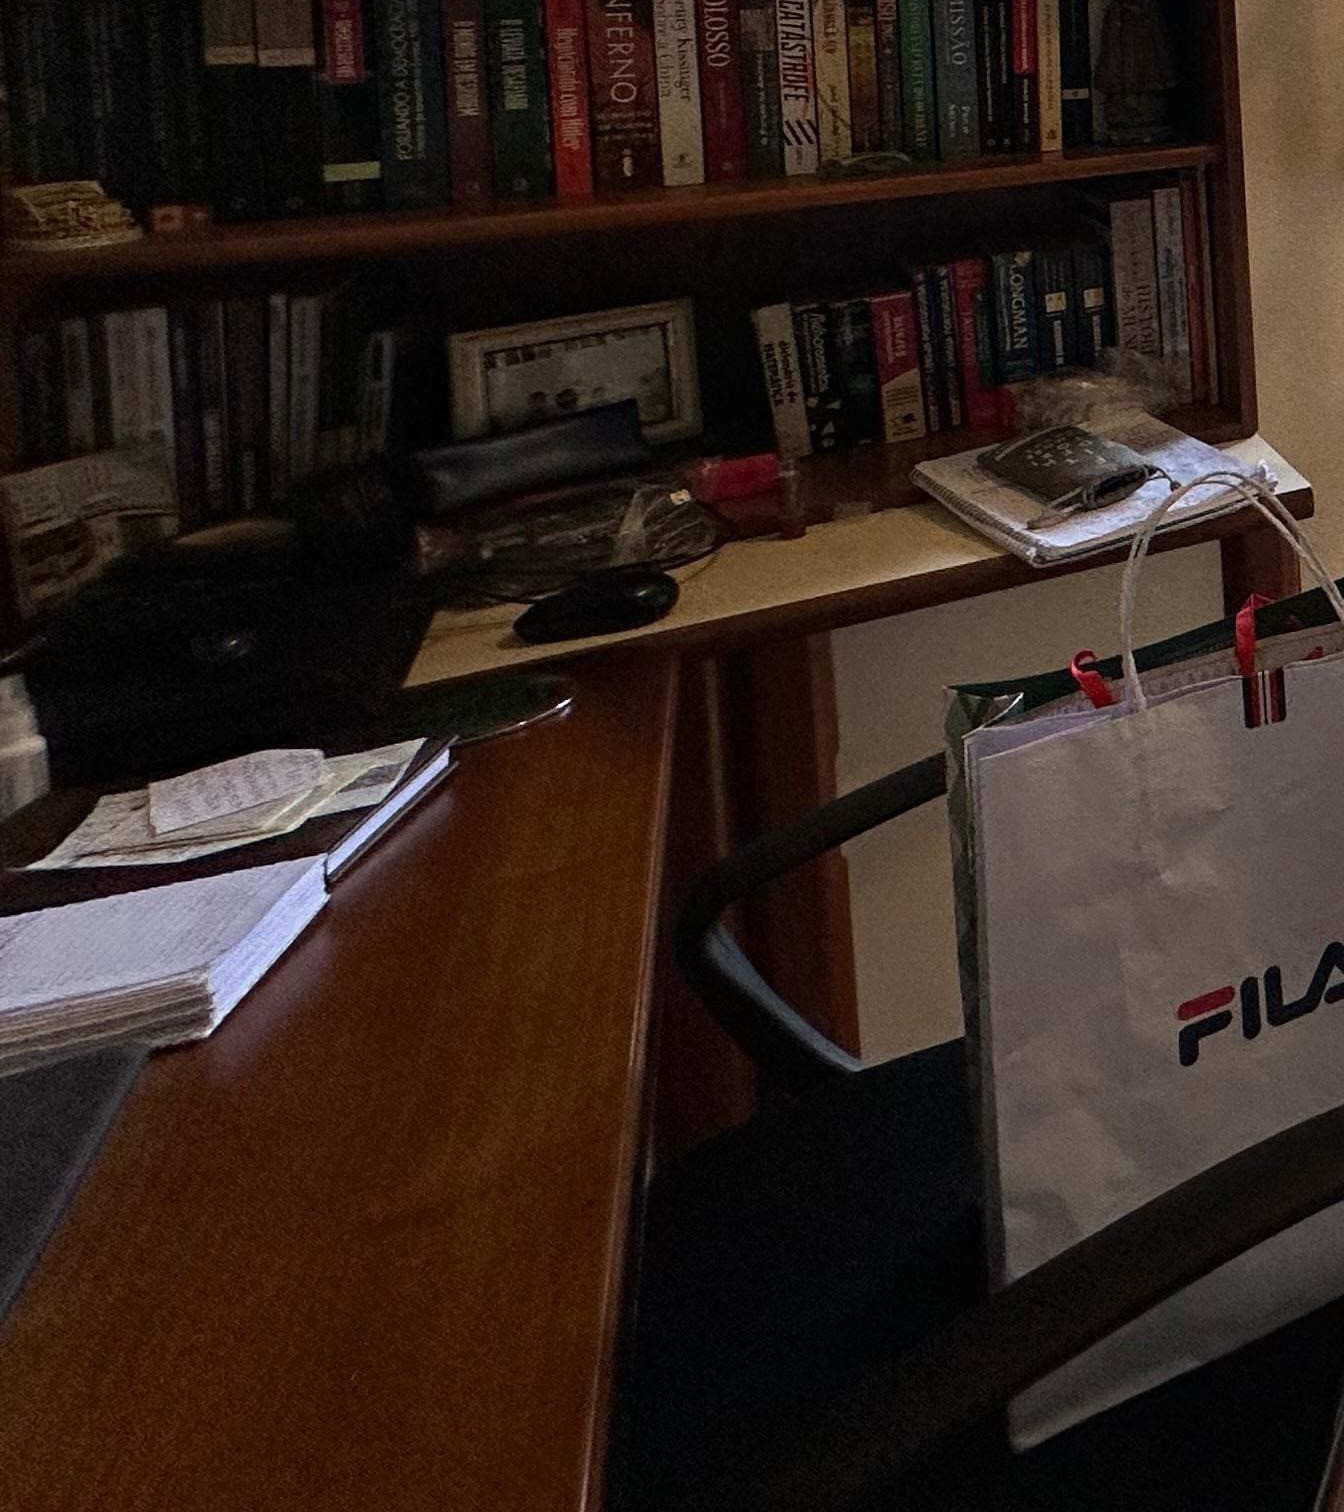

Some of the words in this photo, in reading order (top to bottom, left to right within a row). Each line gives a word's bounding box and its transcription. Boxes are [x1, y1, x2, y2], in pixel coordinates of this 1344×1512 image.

[675, 38, 694, 102] Kissinger
[393, 92, 413, 160] FORJANDO
[559, 94, 580, 117] com
[1007, 263, 1028, 350] LONGMAN
